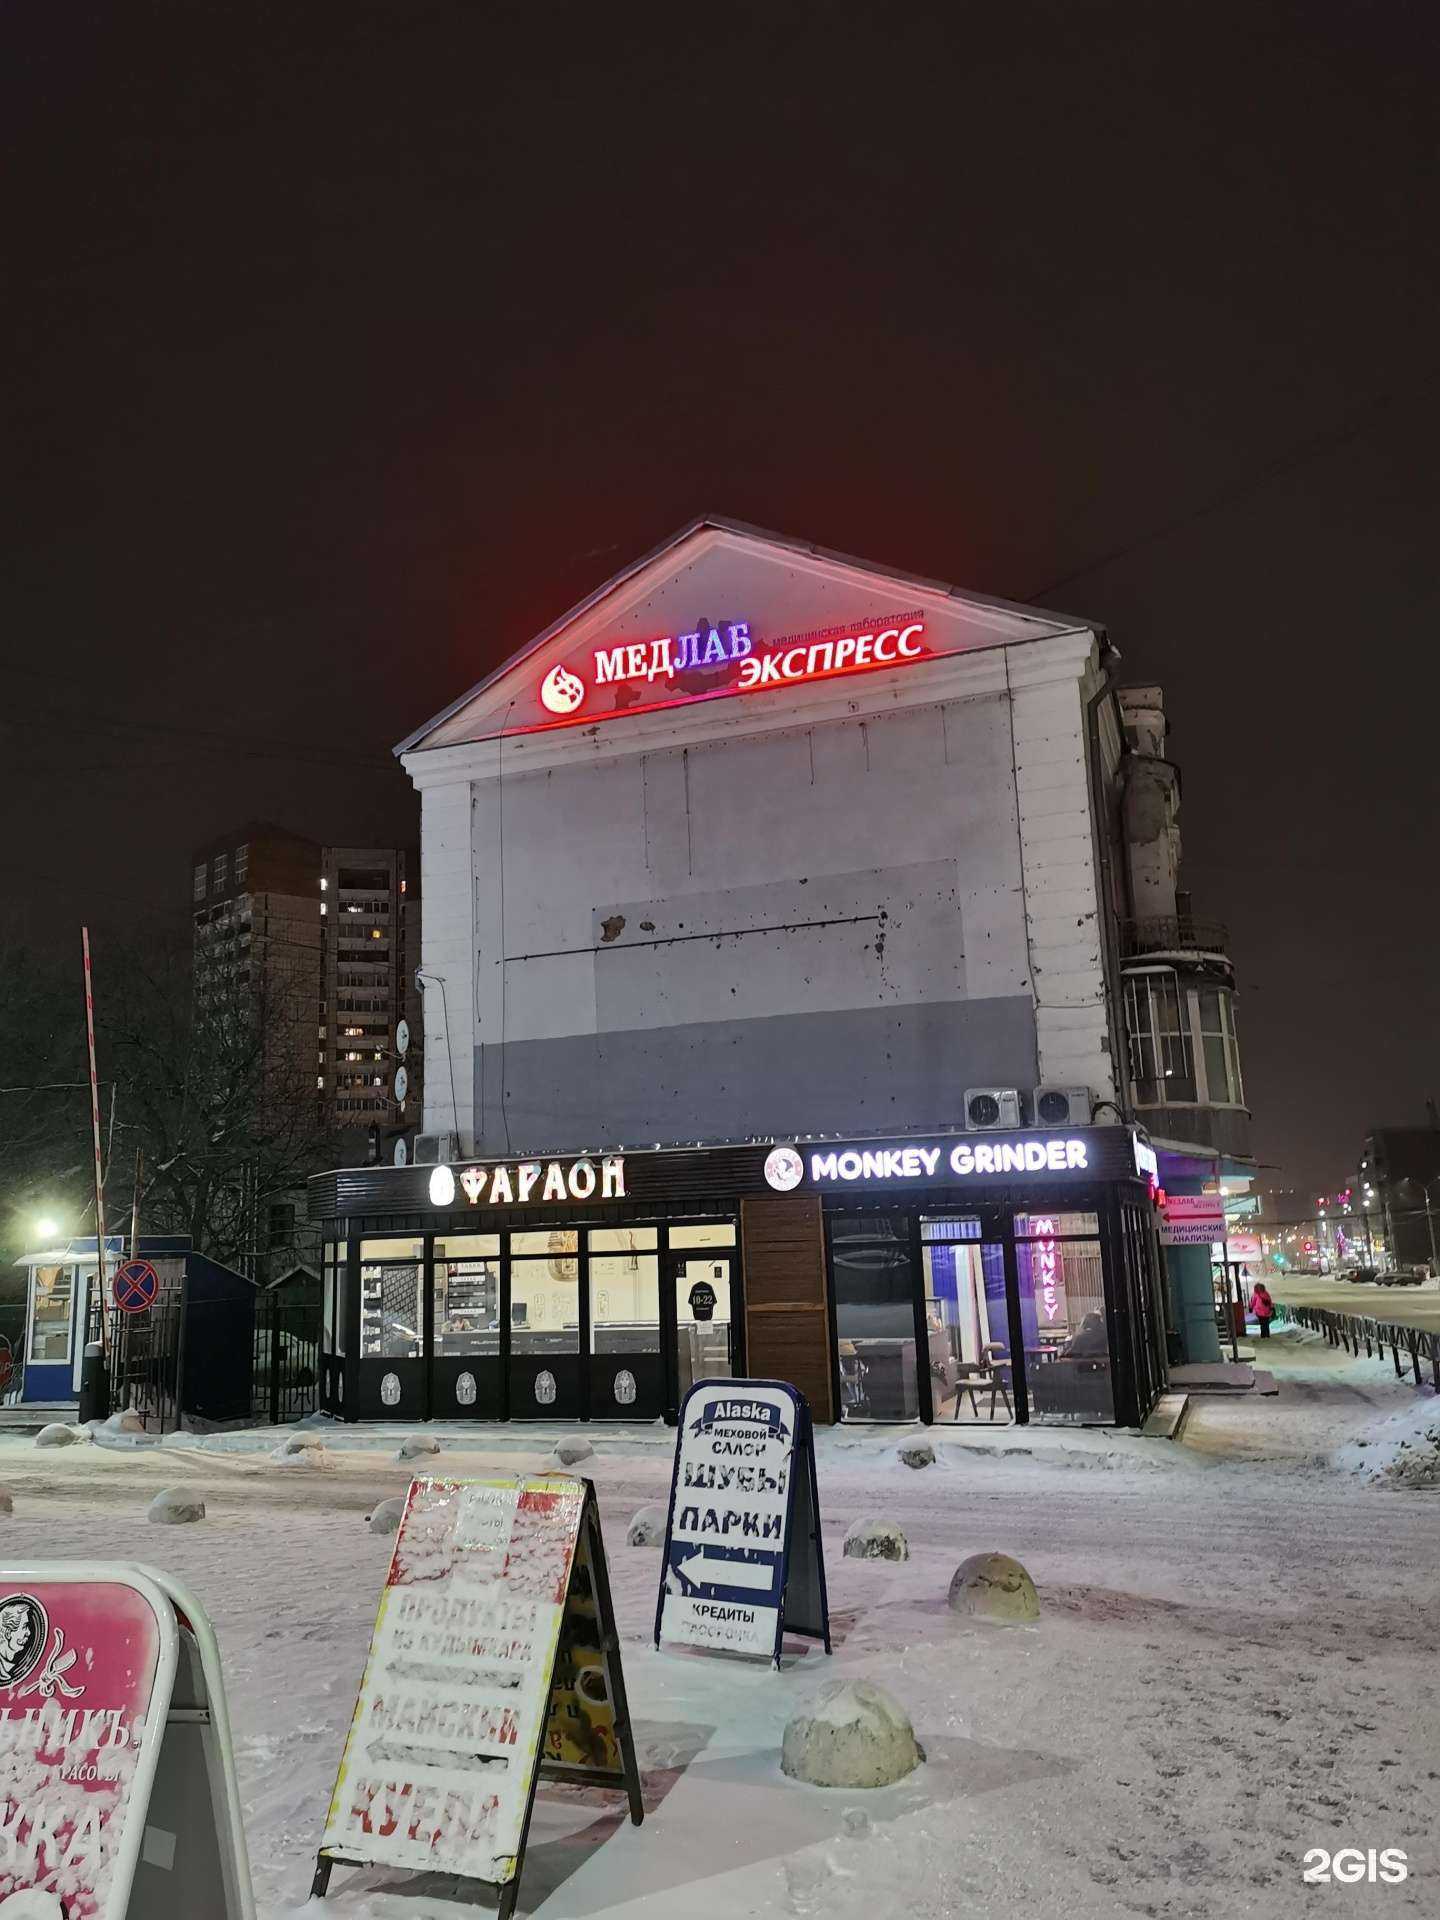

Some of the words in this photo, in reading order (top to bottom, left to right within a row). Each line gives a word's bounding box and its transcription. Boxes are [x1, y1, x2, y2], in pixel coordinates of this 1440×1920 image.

[595, 623, 752, 683] МЕДЛАБ
[738, 624, 924, 687] ЭКСПРЕСС
[811, 1148, 941, 1181] MONKEY
[950, 1139, 1089, 1173] GRINDER
[460, 1156, 626, 1204] ФАРАОН
[1161, 1223, 1225, 1234] МЕДИЦИНСКИЕ
[1173, 1234, 1215, 1243] АНАЛИЗЫ
[714, 1402, 771, 1421] Alaska
[714, 1428, 767, 1440] МЕХОВОЙ
[684, 1462, 786, 1494] ШУБЫ
[679, 1506, 782, 1539] ПАРКИ
[692, 1604, 755, 1623] КРЕДИТЫ
